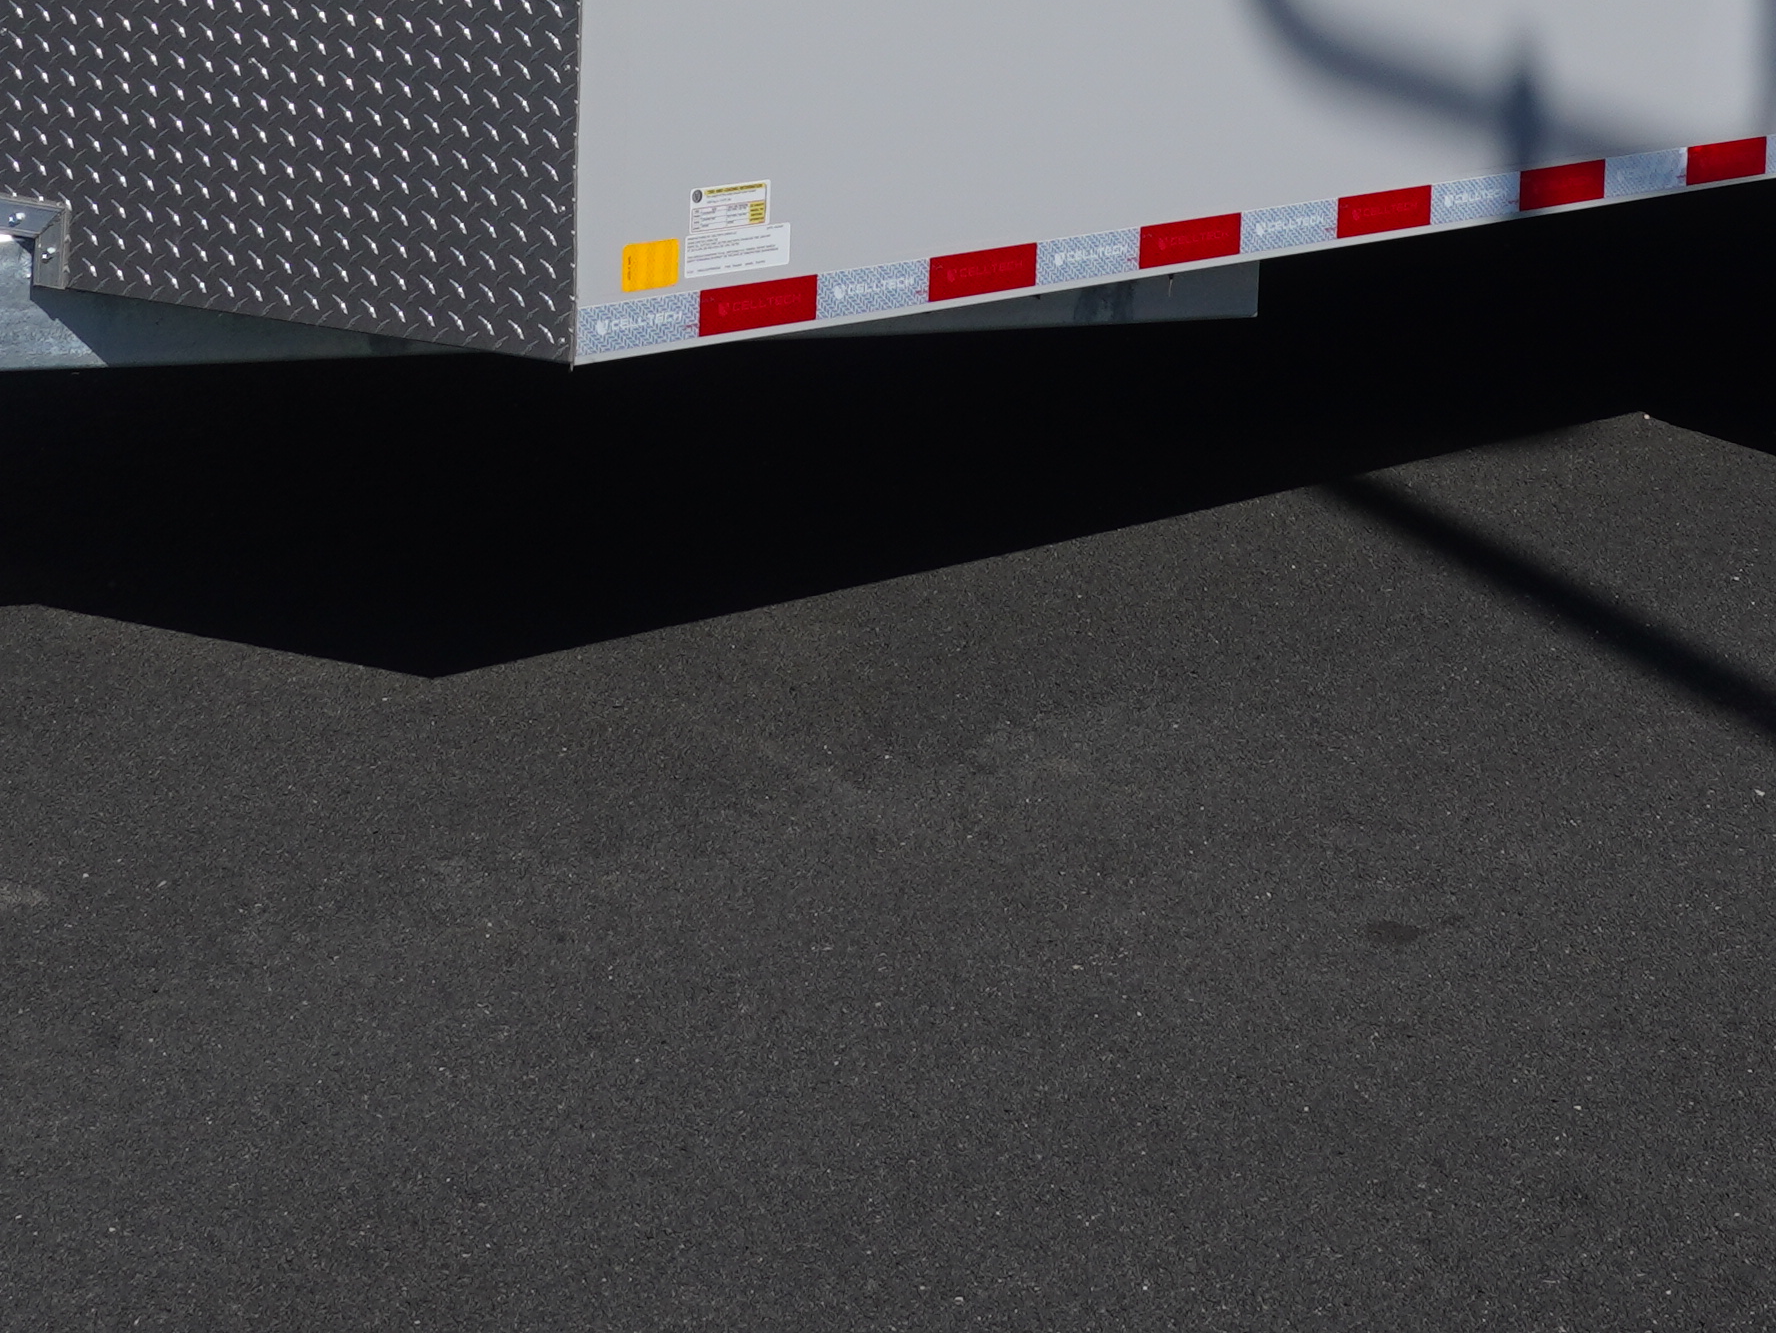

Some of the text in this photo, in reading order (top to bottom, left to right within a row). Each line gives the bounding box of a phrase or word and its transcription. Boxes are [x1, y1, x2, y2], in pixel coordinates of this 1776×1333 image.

[959, 258, 1023, 278] CELLTECH
[732, 292, 802, 313] CELLTECH
[611, 309, 683, 330] CELLTECH
